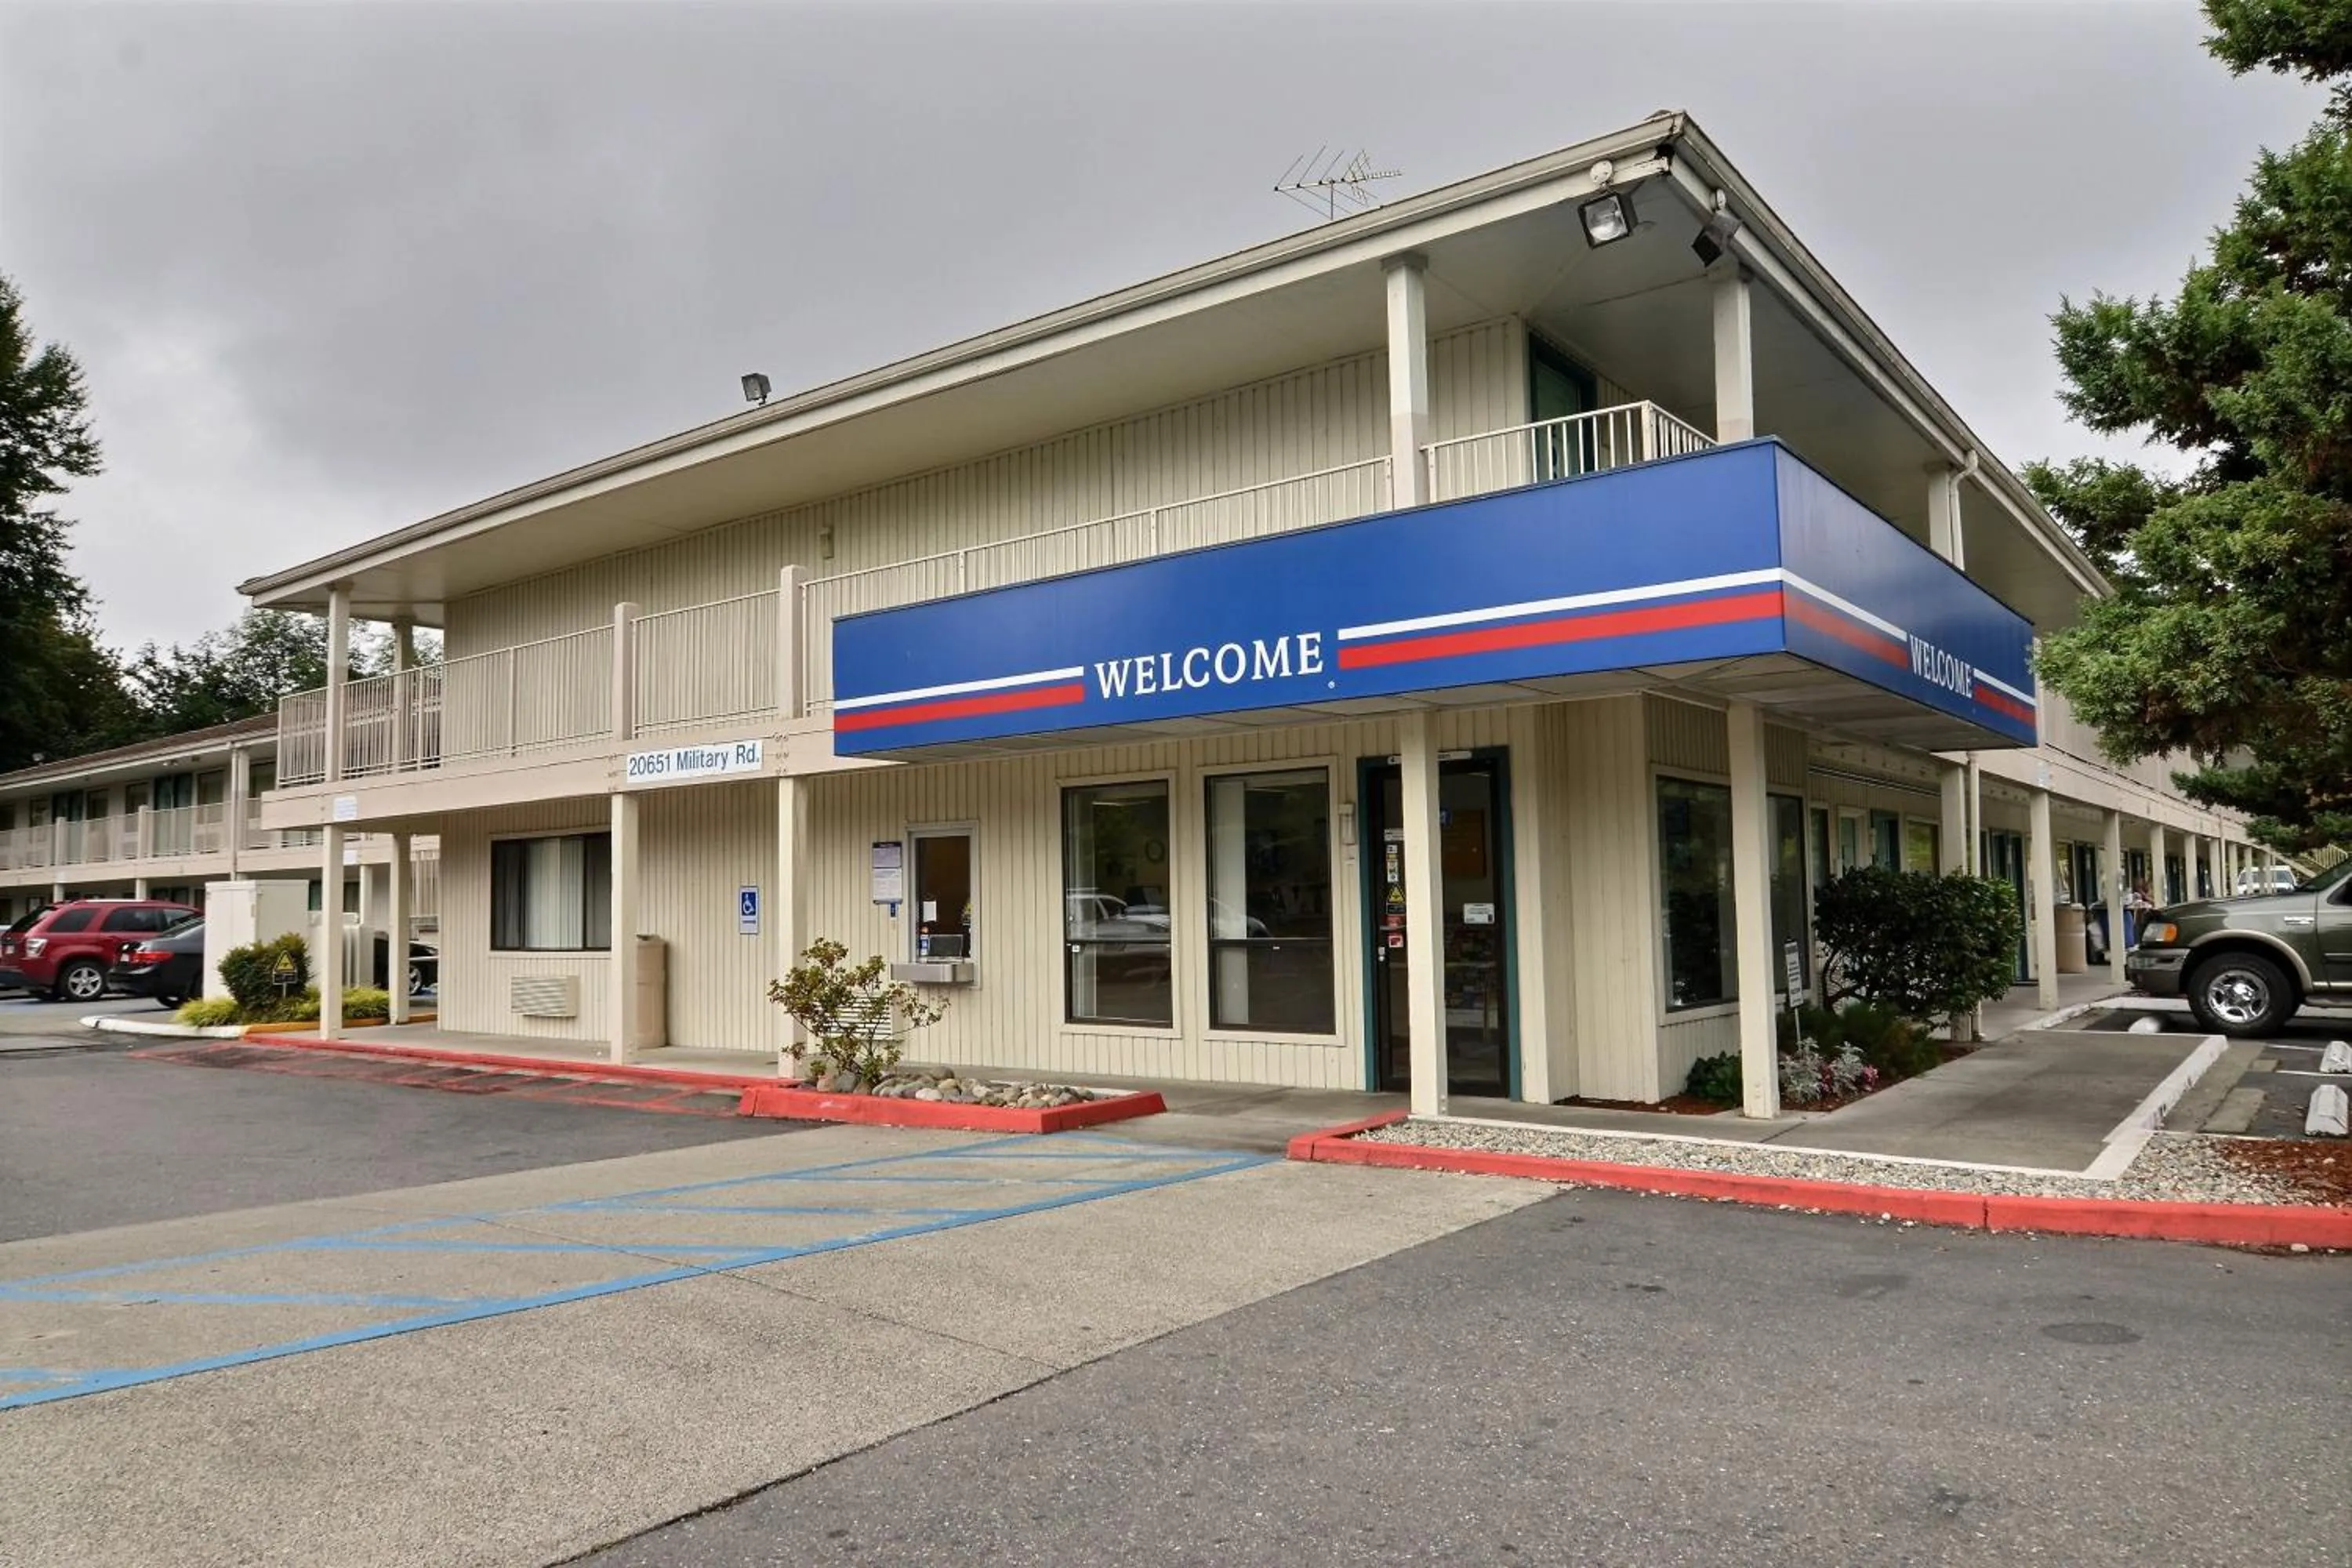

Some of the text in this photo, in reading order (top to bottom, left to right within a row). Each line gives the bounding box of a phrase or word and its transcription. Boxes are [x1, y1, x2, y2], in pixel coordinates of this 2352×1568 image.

[1094, 632, 1323, 699] WELCOME
[1909, 633, 1972, 699] WELCOME
[629, 743, 760, 775] 20651 Military Rd.
